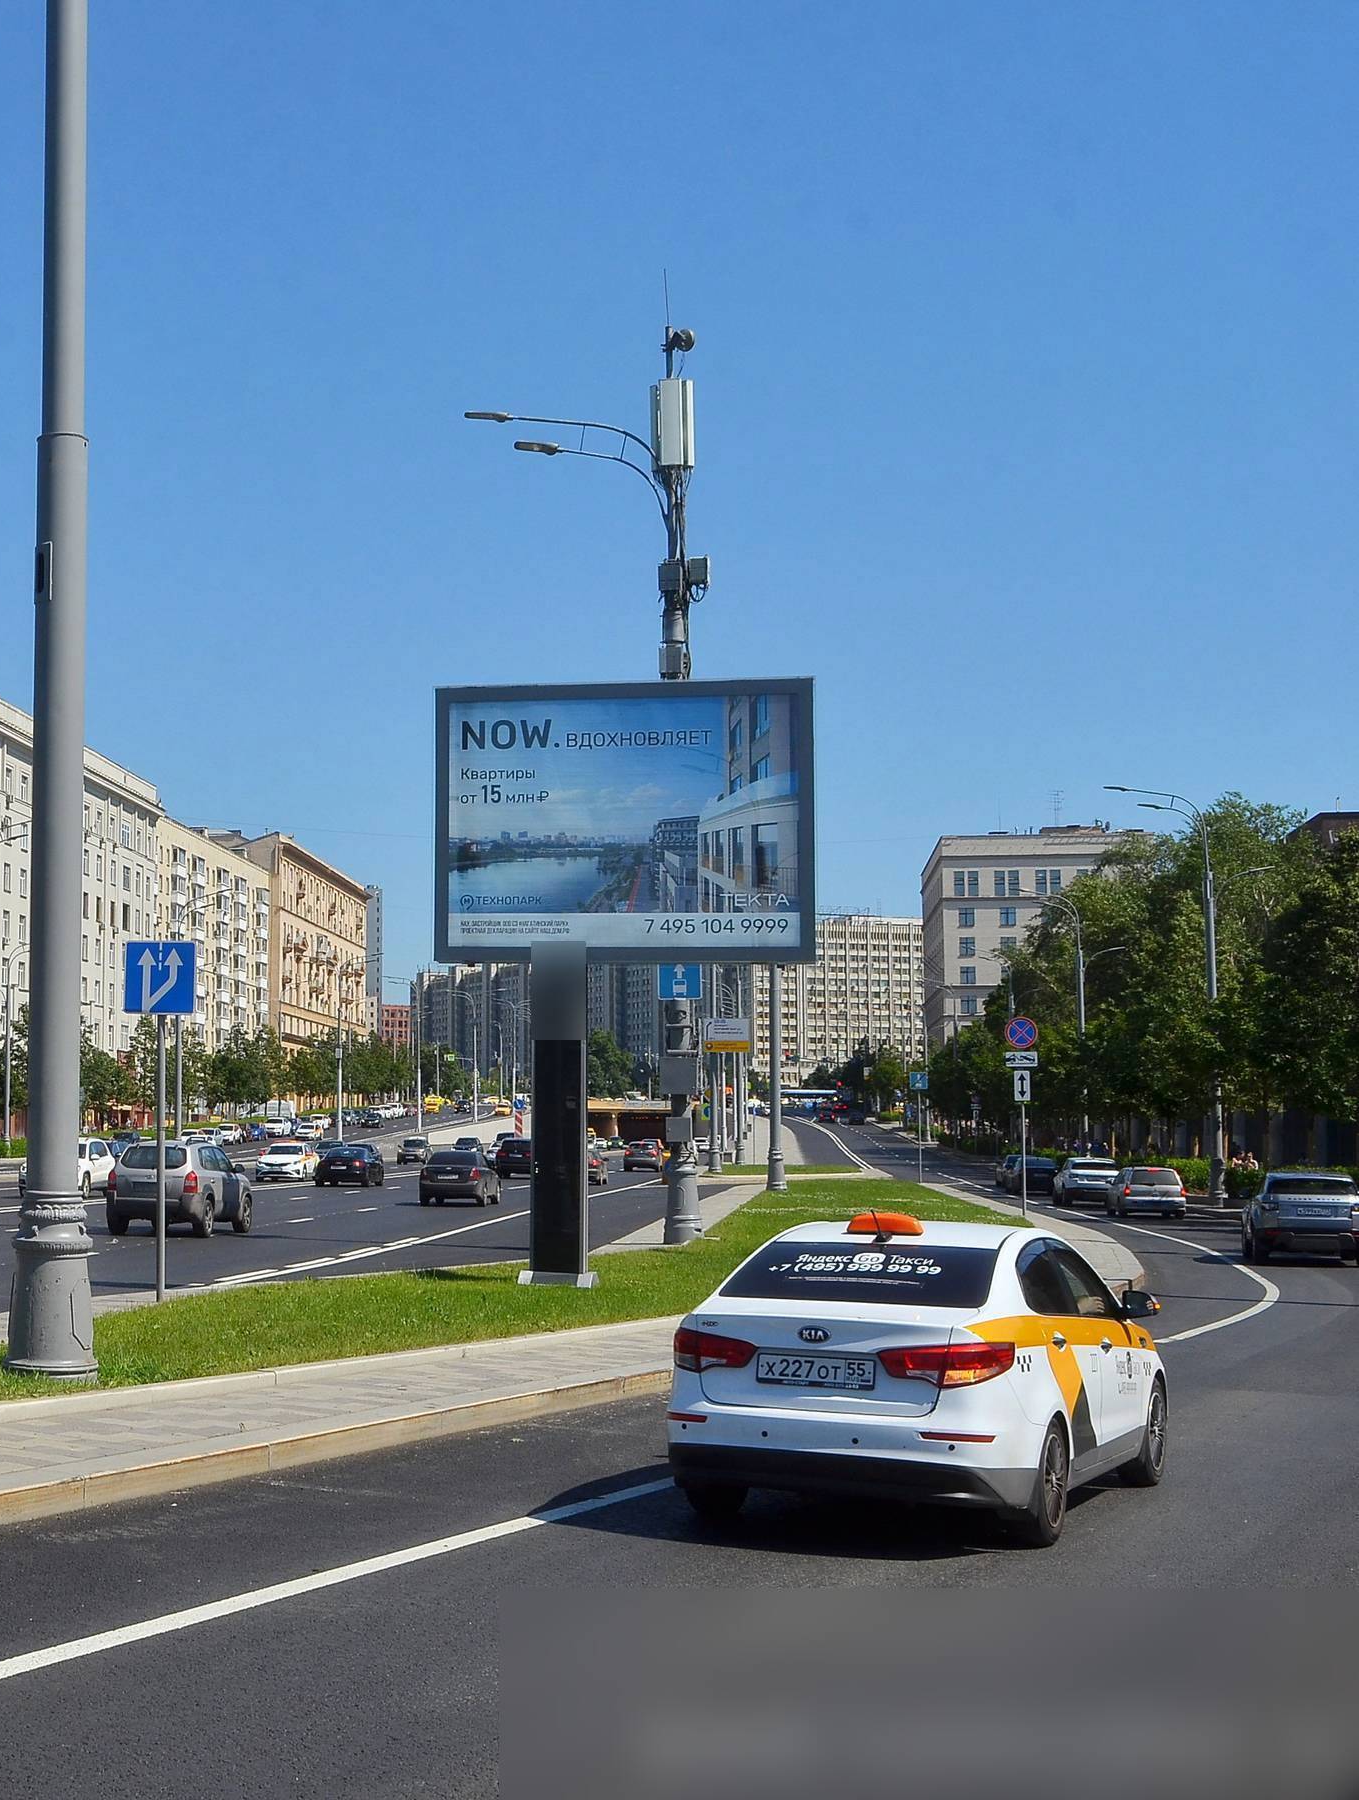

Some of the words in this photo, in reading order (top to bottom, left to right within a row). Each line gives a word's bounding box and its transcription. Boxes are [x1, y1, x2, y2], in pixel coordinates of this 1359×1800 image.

[460, 718, 560, 751] NOW.
[565, 729, 713, 750] ВДОХНОВЛЯЕТ
[460, 767, 536, 782] Квартиры
[460, 793, 478, 804] от
[481, 784, 502, 804] 15
[475, 895, 542, 906] ТЕХНОПАРК
[644, 918, 655, 934] 7
[659, 918, 696, 934] 495
[700, 918, 736, 934] 104
[740, 918, 790, 934] 9999
[796, 1253, 853, 1264] Яндекс
[855, 1253, 883, 1264] Go
[890, 1254, 935, 1266] Такси
[768, 1263, 792, 1273] +7
[794, 1262, 845, 1273] (495)
[846, 1263, 884, 1273] 999
[886, 1264, 913, 1274] 99
[915, 1264, 942, 1275] 99
[801, 1330, 825, 1341] KIA
[846, 1361, 867, 1377] 55
